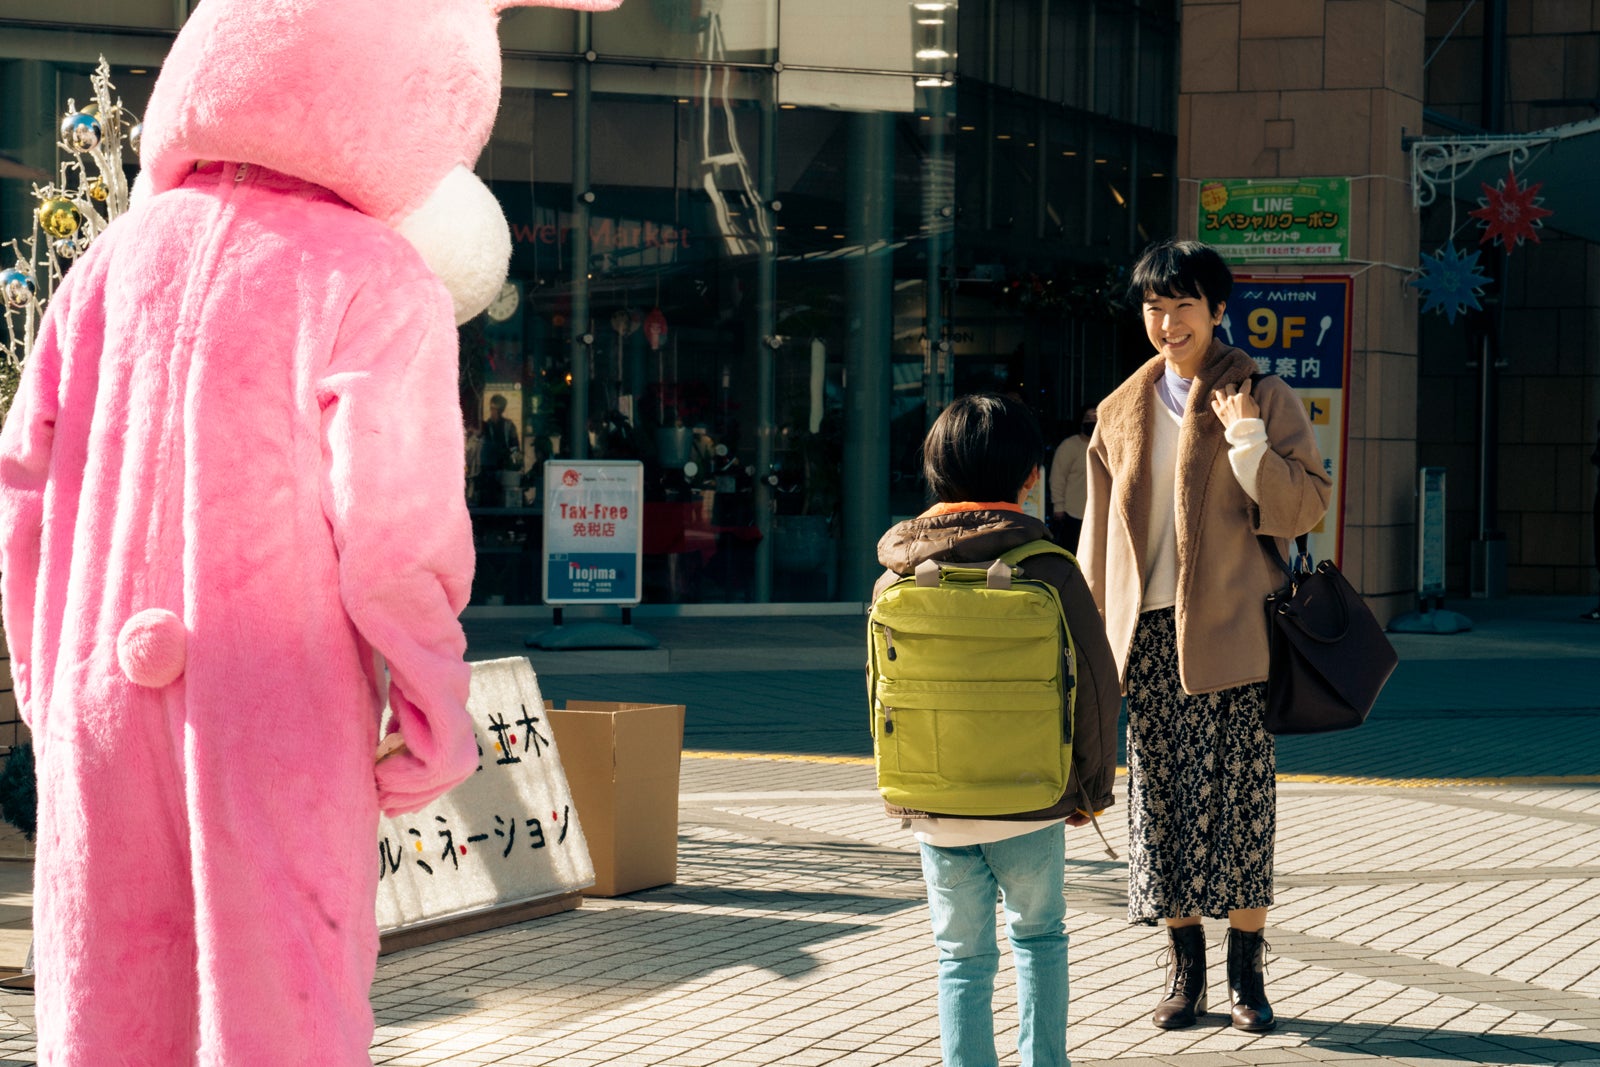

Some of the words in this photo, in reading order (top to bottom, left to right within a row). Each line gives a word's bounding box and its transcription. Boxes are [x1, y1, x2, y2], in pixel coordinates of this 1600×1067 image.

[1252, 198, 1294, 212] LINE
[1206, 212, 1339, 230] スペシャルクーポン
[513, 222, 571, 245] wer
[589, 220, 691, 248] Market
[1243, 231, 1300, 242] プレゼント中
[1247, 308, 1306, 349] 9F
[1252, 357, 1321, 379] 業案内
[560, 503, 628, 520] Tax-Free
[573, 522, 615, 537] 免税店
